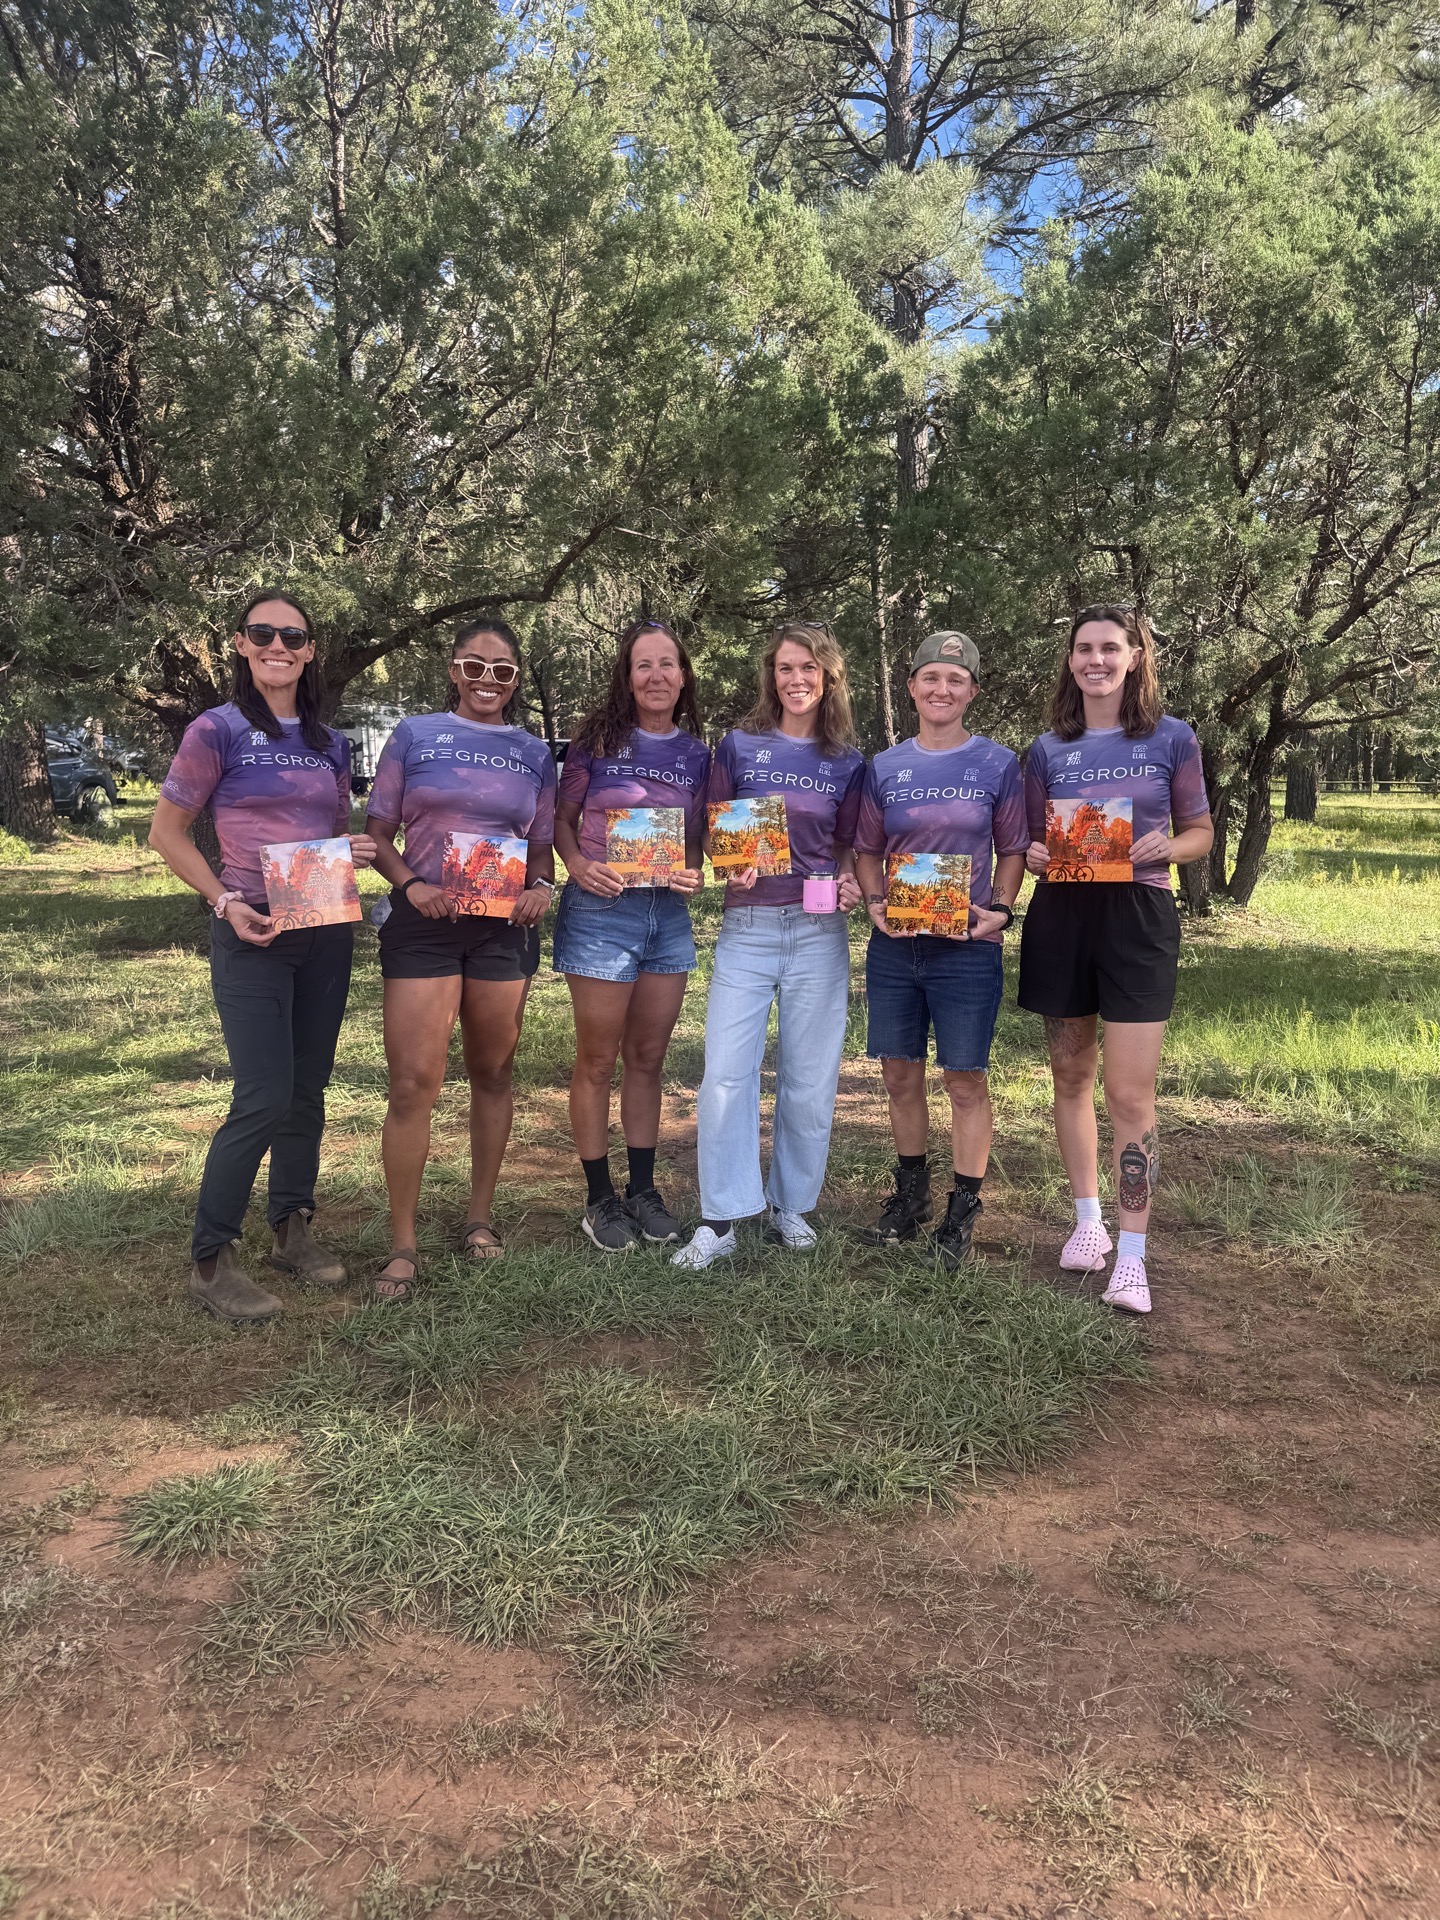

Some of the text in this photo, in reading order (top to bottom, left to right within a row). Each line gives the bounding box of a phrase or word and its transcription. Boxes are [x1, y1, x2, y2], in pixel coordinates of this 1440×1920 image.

[421, 748, 532, 775] REGROUP
[606, 765, 694, 787] REGROUP
[744, 769, 836, 794] REGROUP
[1053, 765, 1157, 784] REGROUP
[886, 787, 986, 804] REGROUP
[1085, 801, 1105, 812] 2nd
[302, 844, 323, 856] 2nd
[483, 838, 502, 850] 2nd
